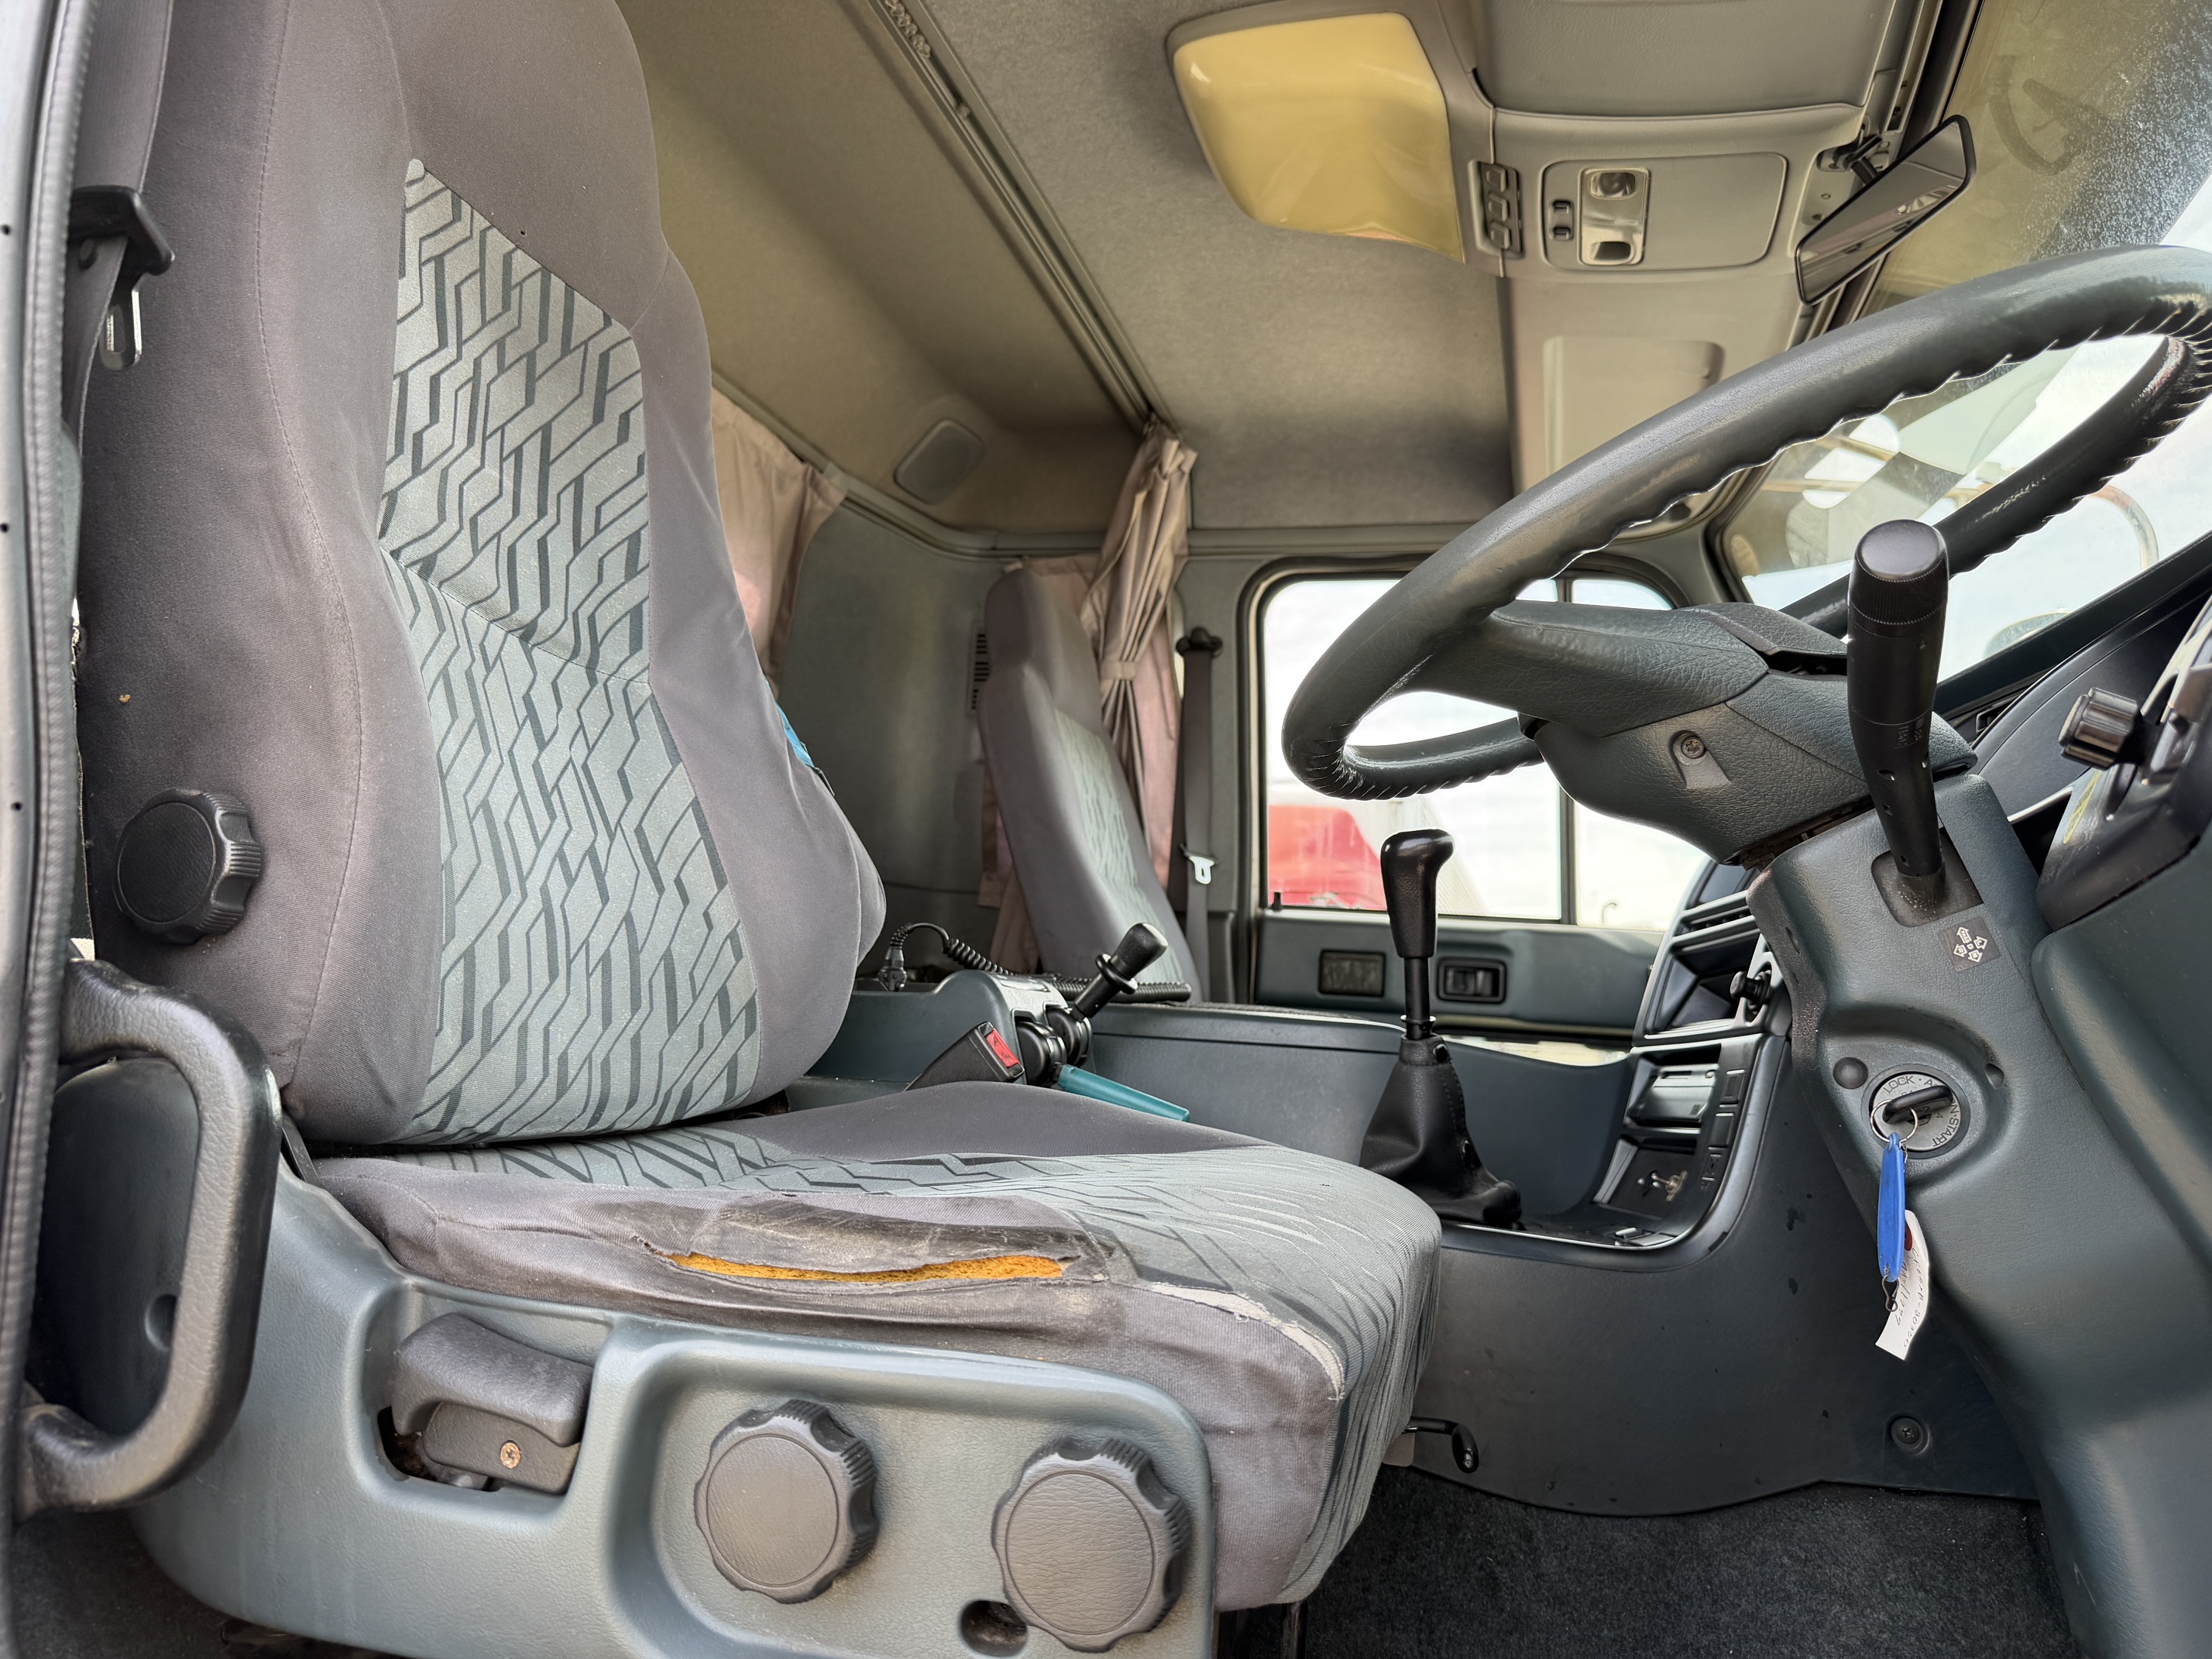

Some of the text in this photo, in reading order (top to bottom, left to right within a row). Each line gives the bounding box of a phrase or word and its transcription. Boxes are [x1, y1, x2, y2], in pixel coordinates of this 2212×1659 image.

[1960, 930, 1970, 943] PASS
[1883, 1075, 1915, 1094] LOCK
[1932, 1116, 1960, 1147] START
